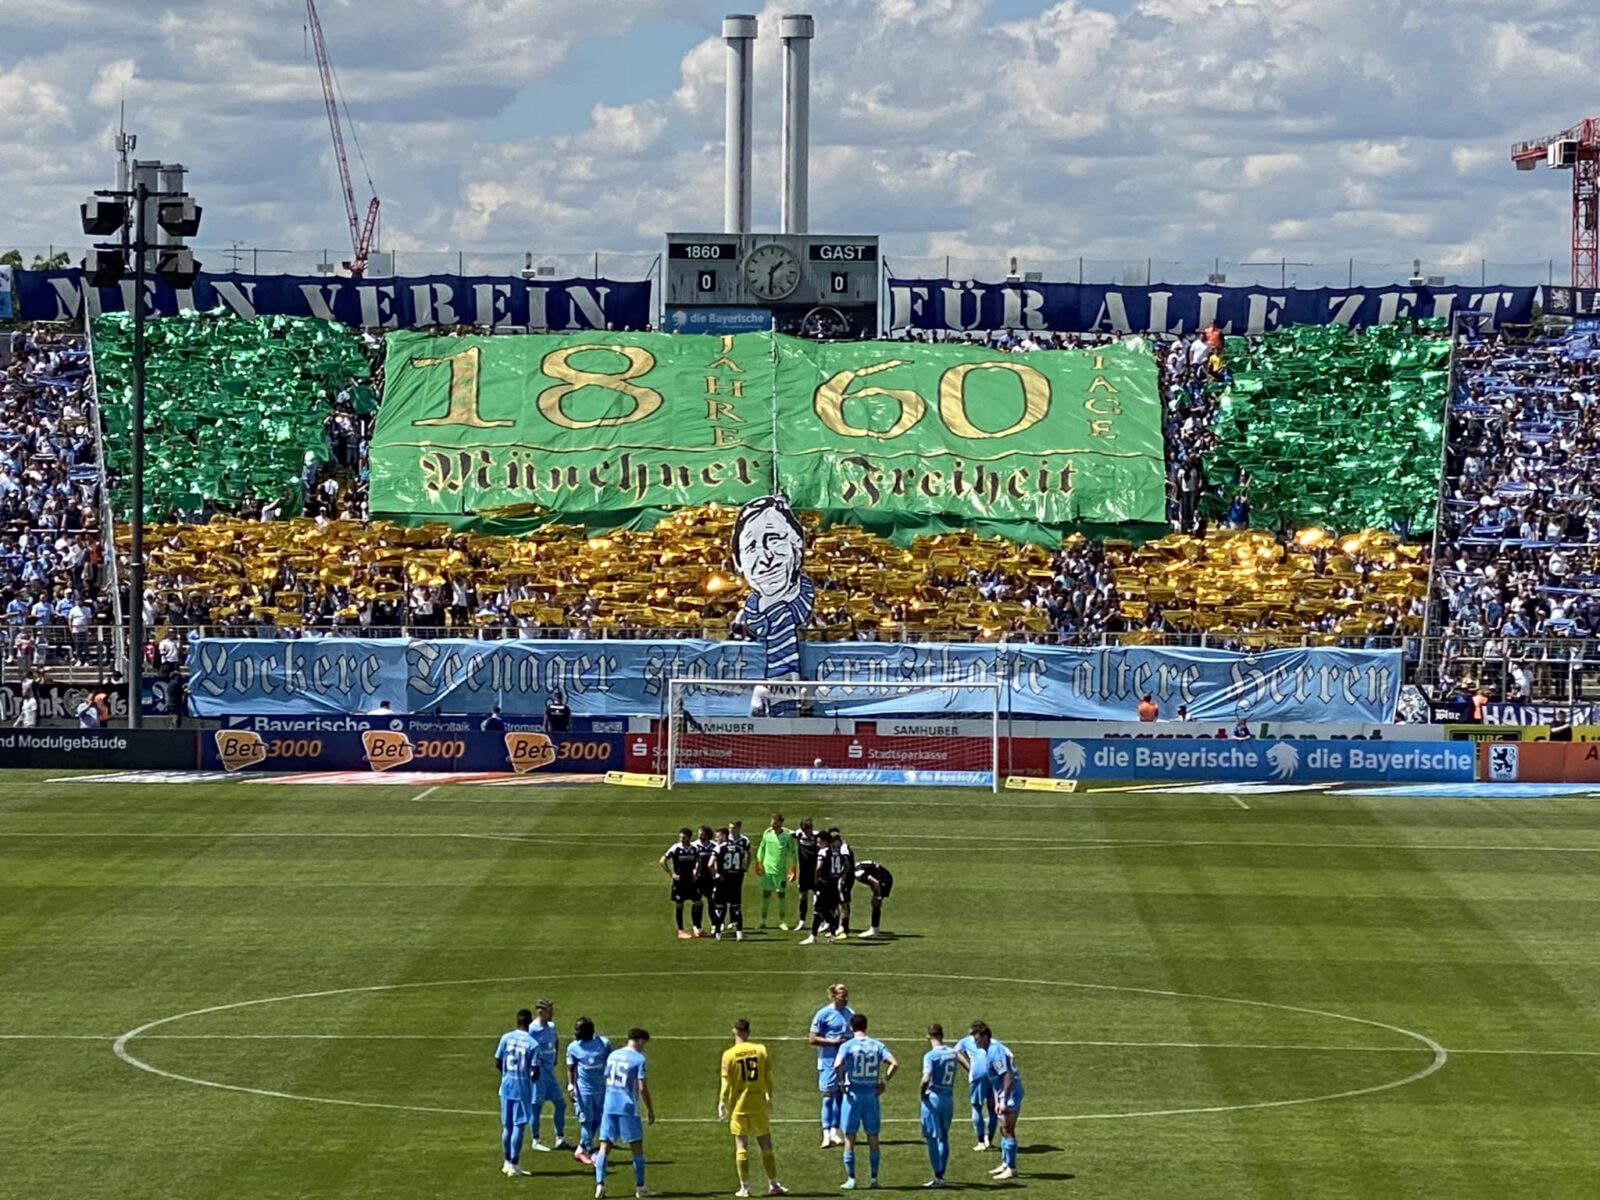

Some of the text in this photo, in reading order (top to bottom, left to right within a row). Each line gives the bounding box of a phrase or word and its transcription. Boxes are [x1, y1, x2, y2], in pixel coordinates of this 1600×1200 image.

[685, 246, 720, 259] 1860
[820, 246, 865, 260] GAST
[702, 275, 712, 290] 0
[834, 277, 844, 291] 0
[299, 283, 611, 330] VEREIN
[890, 280, 1514, 336] FÜR ALLE ZEIT
[690, 313, 765, 325] die Bayerische
[409, 344, 664, 430] 18
[703, 334, 748, 448] JAHRE
[1083, 351, 1123, 439] TAGE
[813, 359, 1052, 442] 60
[419, 450, 760, 501] Münchner
[836, 456, 1078, 507] Freiheit
[200, 642, 381, 696] Lockere
[1072, 647, 1200, 703] ältere
[254, 716, 371, 732] Bayerische
[894, 725, 959, 736] SAMHUBER
[18, 735, 127, 751] Modulgebäude
[224, 738, 322, 757] Bet 3000
[371, 739, 466, 758] Bet 3000
[513, 740, 611, 760] Bet 3000
[1094, 747, 1258, 771] die Bayerische
[1307, 749, 1471, 772] die Bayerische
[723, 853, 741, 870] 34
[831, 856, 843, 873] 14
